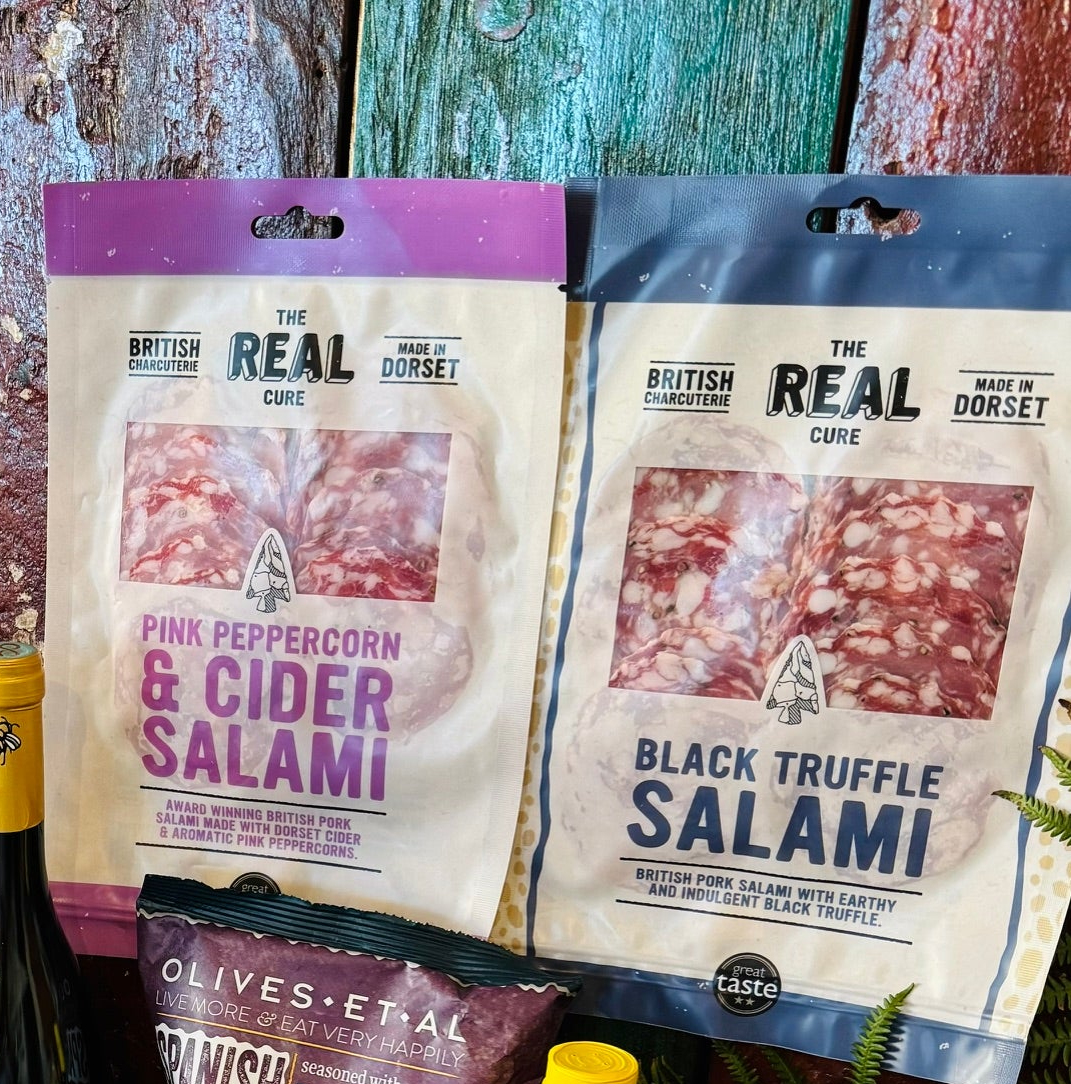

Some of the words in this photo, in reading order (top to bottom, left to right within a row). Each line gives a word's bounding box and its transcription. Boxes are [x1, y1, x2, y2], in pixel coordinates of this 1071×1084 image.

[276, 309, 307, 327] THE
[128, 338, 201, 359] BRITISH
[226, 332, 354, 385] REAL
[397, 342, 431, 356] MADE
[433, 344, 446, 357] IN
[830, 339, 868, 358] THE
[128, 360, 199, 373] CHARCUTERIE
[381, 357, 461, 380] DORSET
[646, 368, 735, 392] BRITISH
[263, 389, 306, 407] CURE
[643, 391, 731, 407] CHARCUTERIE
[766, 362, 921, 422] REAL
[975, 379, 1014, 393] MADE
[1018, 380, 1034, 393] IN
[953, 394, 1050, 420] DORSET
[809, 427, 862, 446] CURE
[141, 613, 203, 647] PINK
[212, 620, 402, 661] PEPPERCORN
[141, 648, 180, 713] &
[205, 655, 393, 732] CIDER
[141, 715, 388, 802] SALAMI
[634, 737, 759, 783] BLACK
[774, 749, 945, 800] TRUFFLE
[155, 812, 200, 828] SALAMI
[203, 816, 236, 832] MADE
[239, 821, 271, 836] WITH
[274, 825, 322, 841] DORSET
[325, 830, 362, 846] CIDER
[165, 799, 207, 816] AWARD
[210, 804, 263, 821] WINNING
[266, 810, 315, 827] BRITISH
[318, 816, 351, 831] PORK
[626, 779, 933, 878] SALAMI
[159, 826, 168, 839] &
[171, 828, 234, 845] AROMATIC
[236, 834, 265, 848] PINK
[268, 837, 359, 860] PEPPERCORNS.
[635, 867, 693, 886] BRITISH
[696, 874, 734, 891] PORK
[739, 879, 793, 899] SALAMI
[797, 887, 835, 904] WITH
[838, 892, 897, 914] EARTHY
[648, 883, 677, 899] AND
[681, 887, 758, 910] INDULGENT
[763, 896, 811, 917] BLACK
[816, 904, 882, 928] TRUFFLE.
[731, 963, 767, 980] great
[716, 972, 779, 1000] taste
[154, 989, 188, 1010] LIVE
[191, 993, 252, 1023] MORE
[256, 1010, 277, 1028] &
[280, 1016, 319, 1037] EAT
[323, 1023, 378, 1049] VERY
[380, 1036, 466, 1069] HAPPILY
